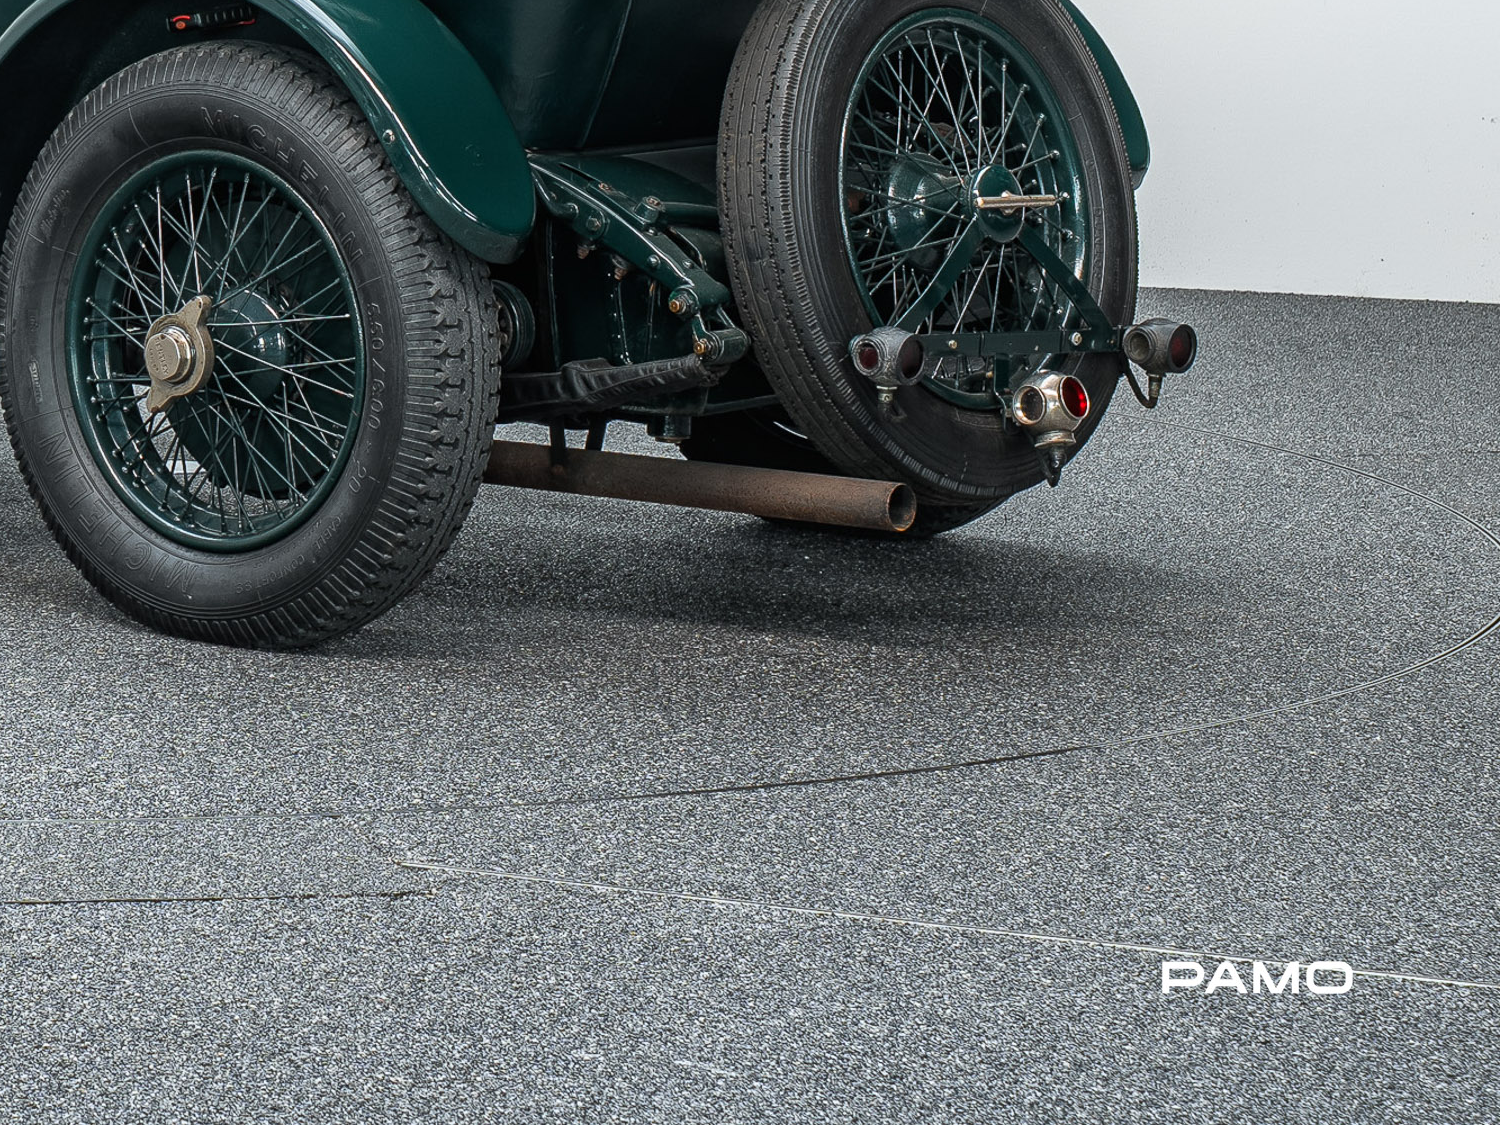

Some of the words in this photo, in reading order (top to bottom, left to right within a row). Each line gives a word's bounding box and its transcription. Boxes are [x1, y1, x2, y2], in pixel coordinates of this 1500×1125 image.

[200, 106, 363, 265] MICHELIN
[39, 432, 198, 591] MICHELIN
[348, 459, 367, 493] 20
